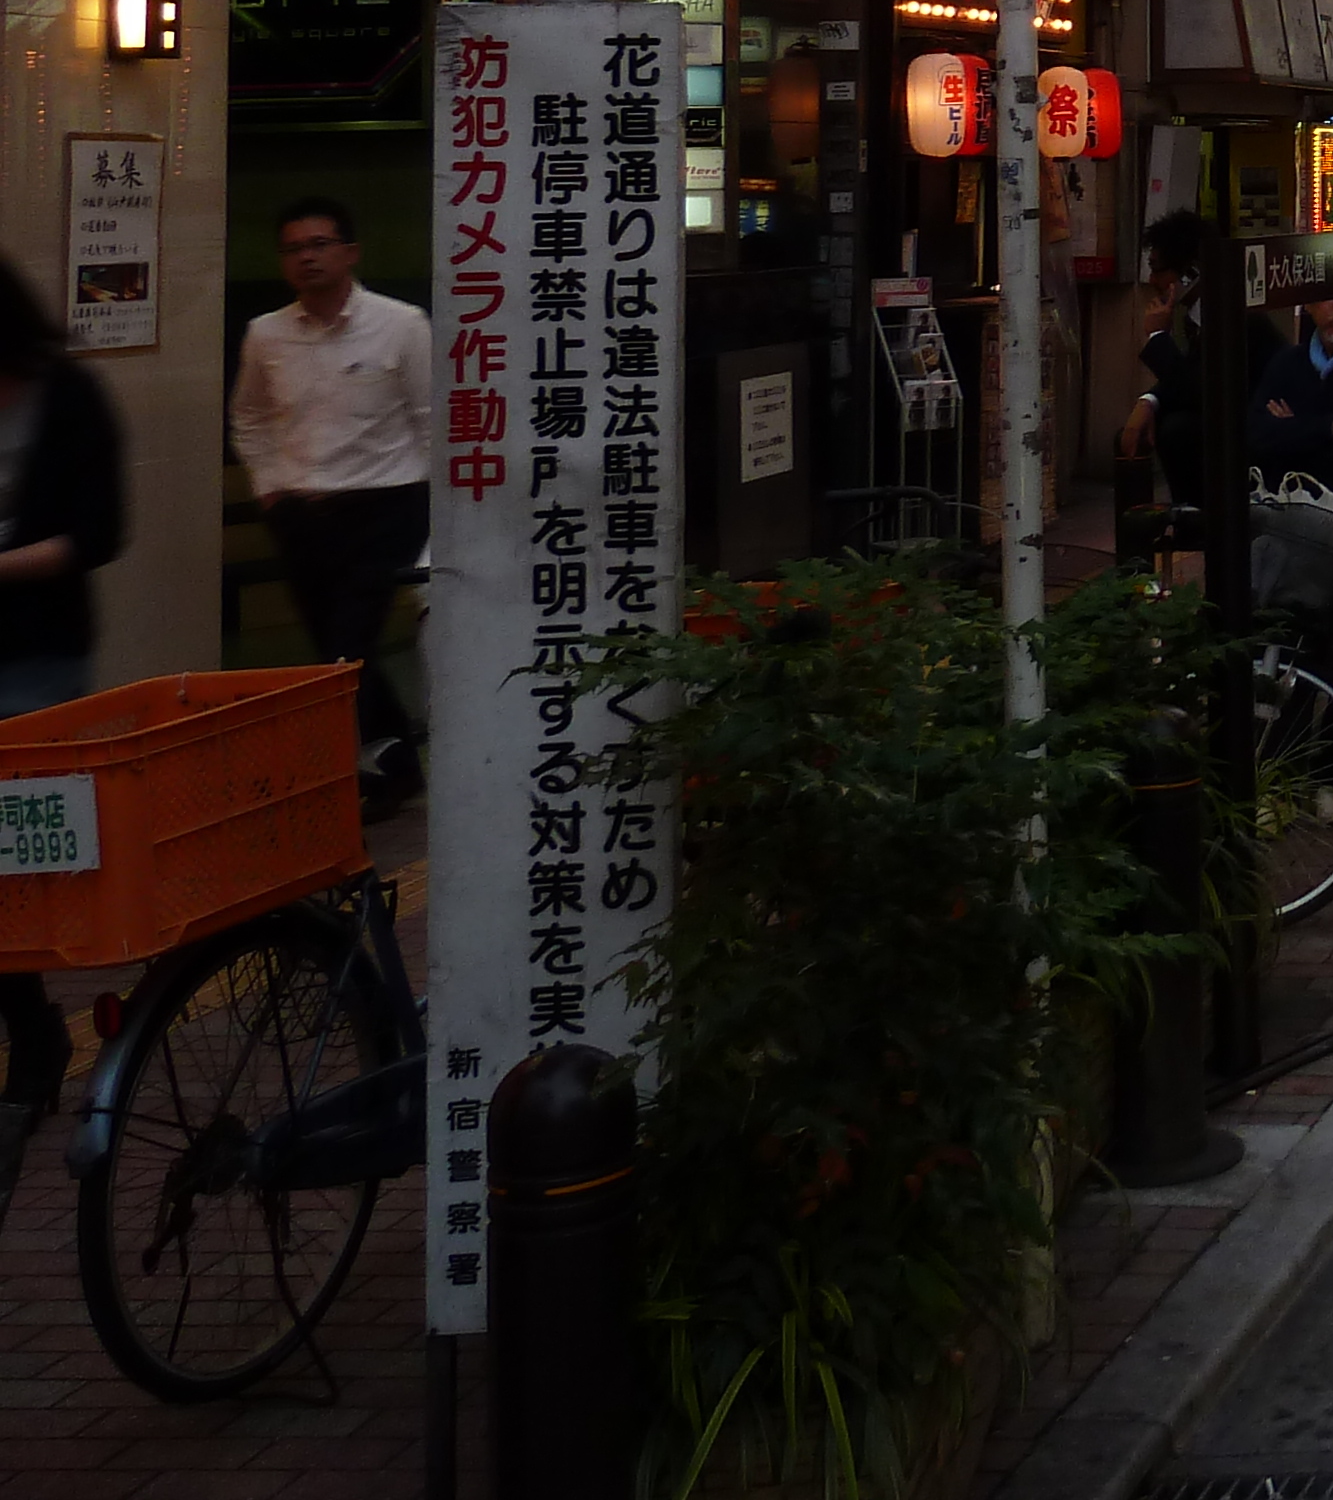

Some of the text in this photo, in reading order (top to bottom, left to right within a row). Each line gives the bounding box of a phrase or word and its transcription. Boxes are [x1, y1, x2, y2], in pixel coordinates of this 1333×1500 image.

[943, 74, 963, 145] 生 ビール
[1047, 84, 1079, 139] 祭
[447, 34, 509, 502] 防犯カメラ作動中
[1268, 252, 1326, 291] 大久保公園
[0, 793, 65, 832] 司本店
[446, 1047, 482, 1287] 新宿警察署
